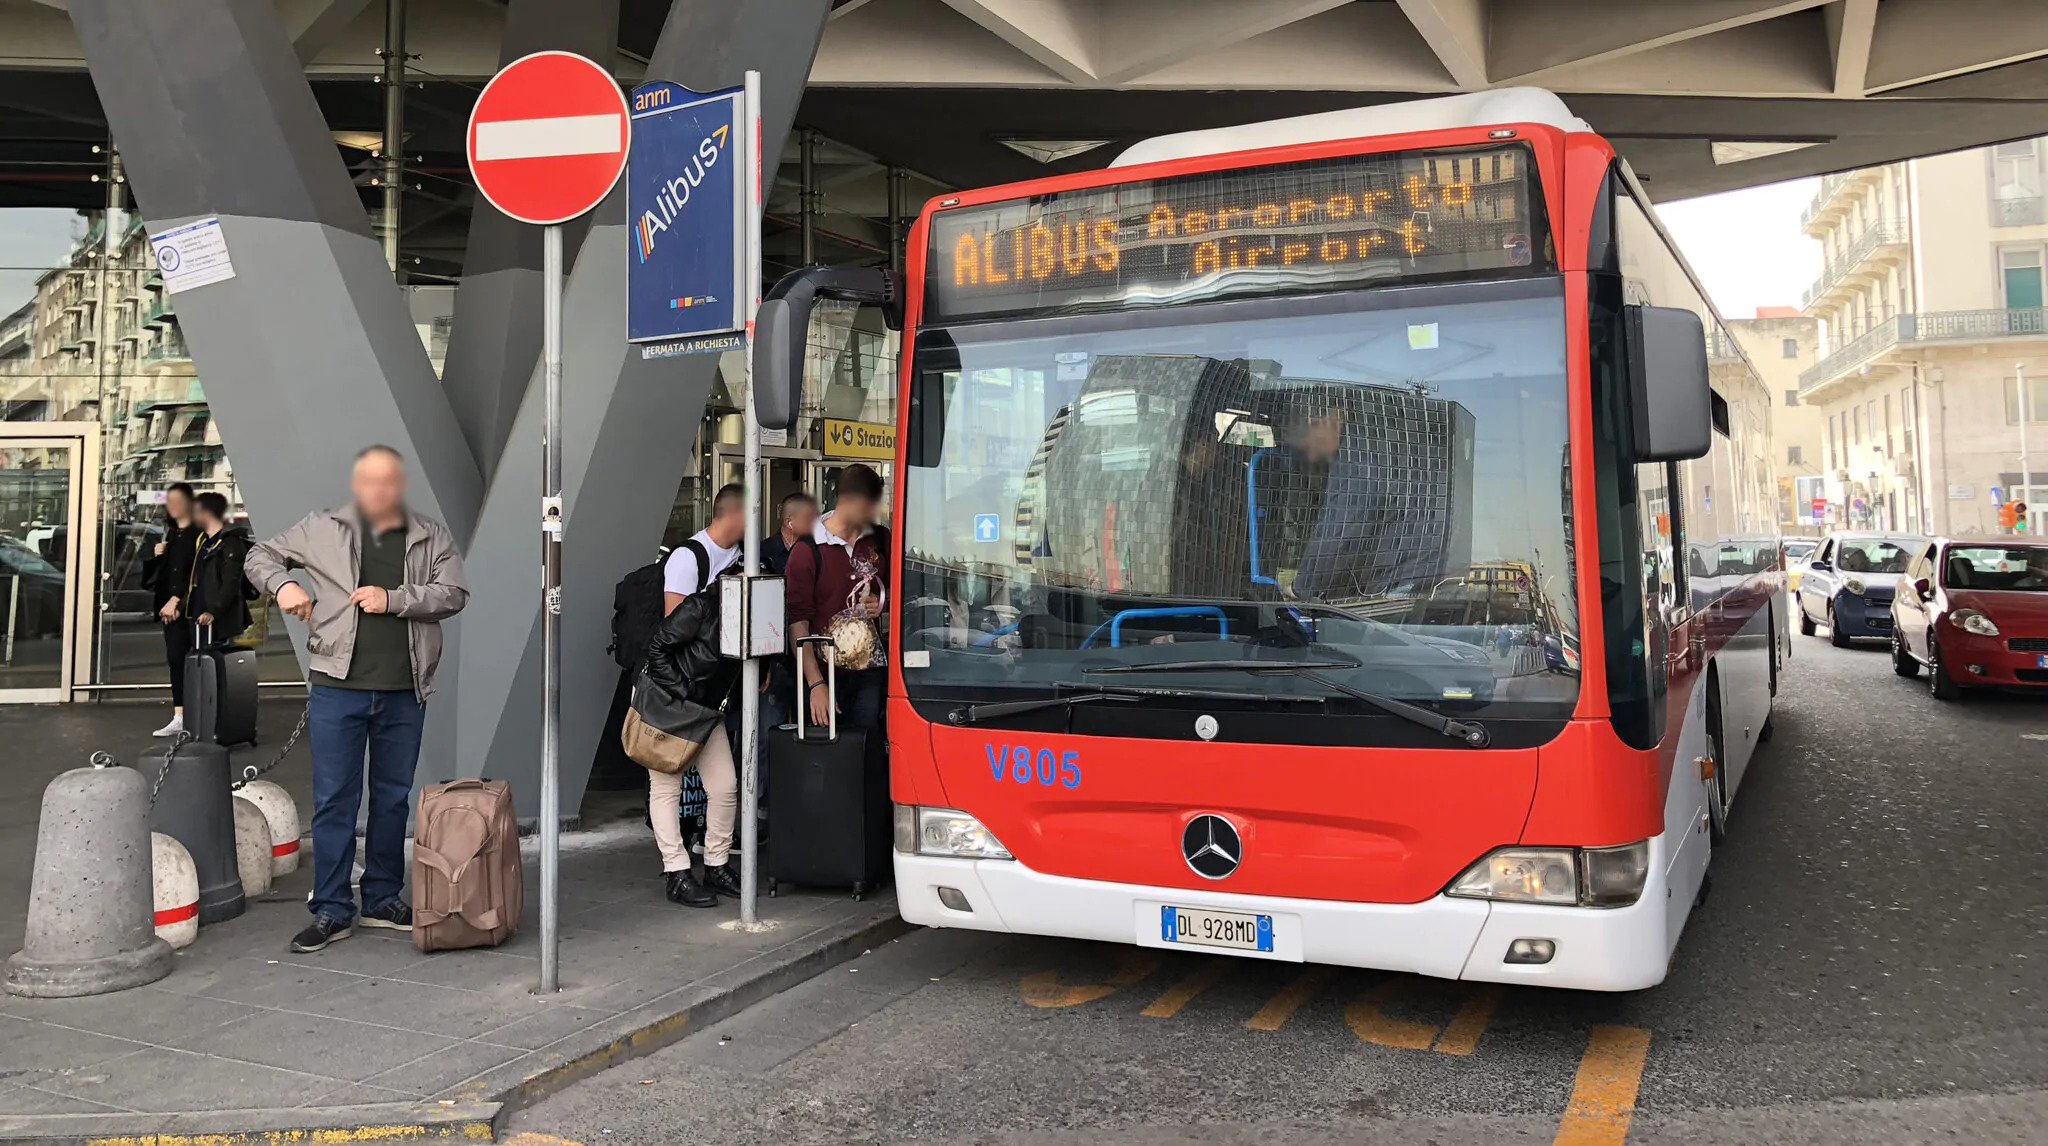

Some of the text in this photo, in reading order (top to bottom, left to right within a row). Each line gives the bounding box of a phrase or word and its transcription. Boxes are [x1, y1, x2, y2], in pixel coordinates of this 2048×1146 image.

[635, 87, 670, 111] anm
[645, 136, 719, 251] Alibus
[1147, 175, 1472, 239] Aeroporto
[955, 219, 1119, 287] ALIBUS
[1194, 219, 1426, 274] Airport
[646, 337, 740, 356] FERMATA A RICHIESTA
[986, 744, 1081, 789] V805
[1178, 915, 1197, 937] DL
[1203, 918, 1256, 943] 928MD
